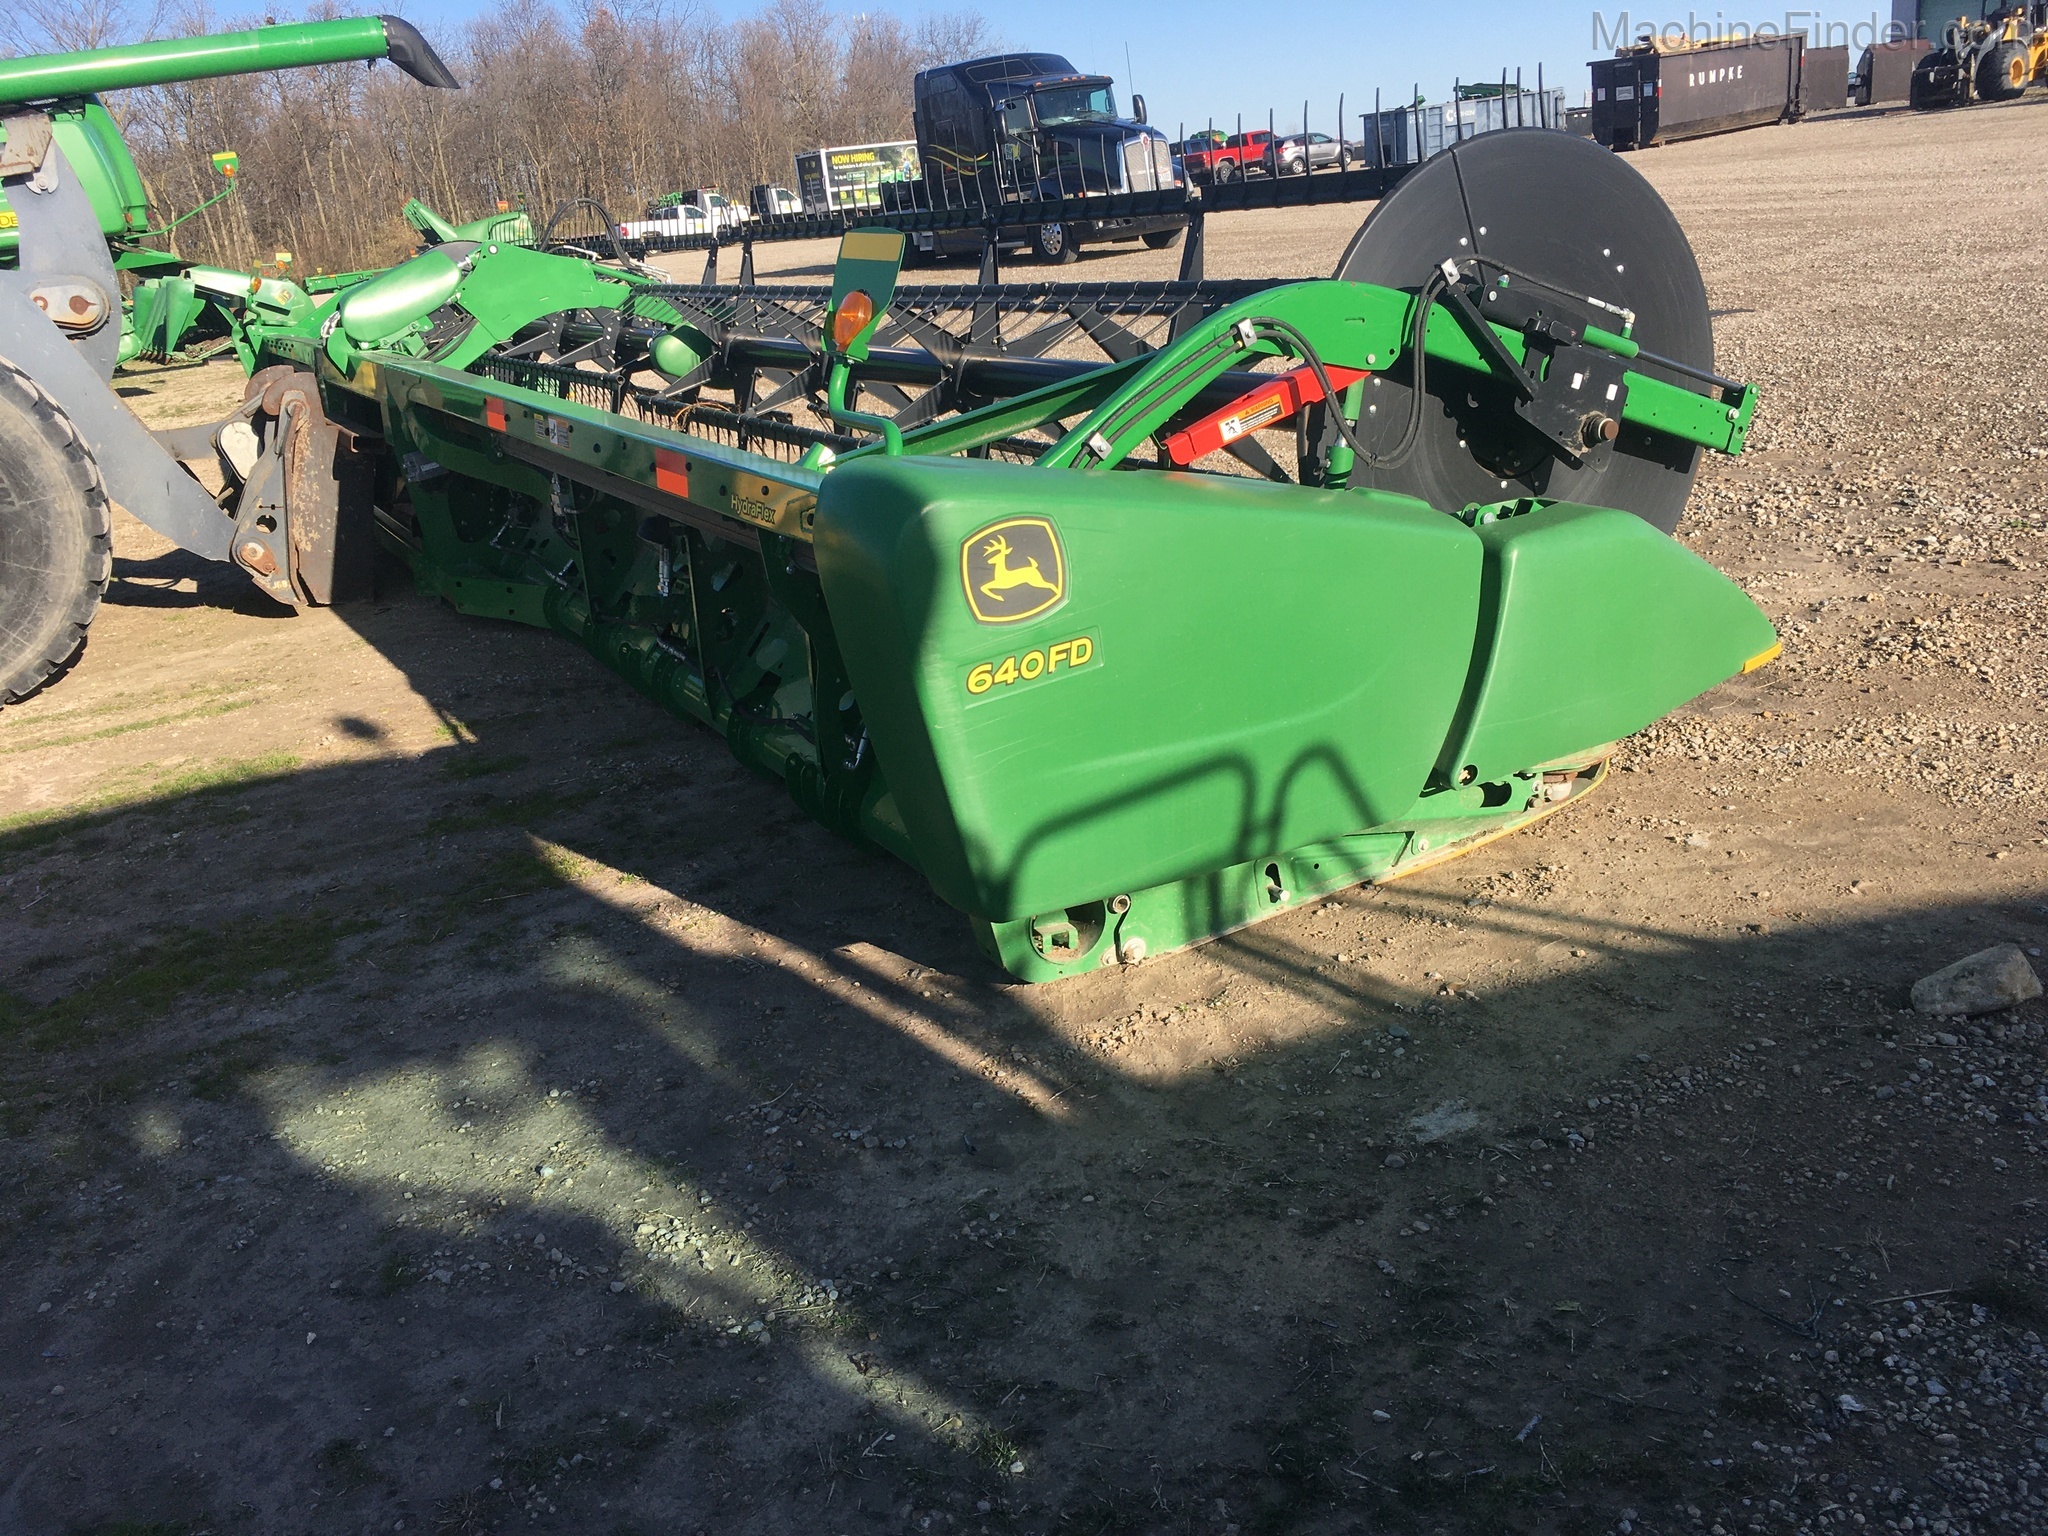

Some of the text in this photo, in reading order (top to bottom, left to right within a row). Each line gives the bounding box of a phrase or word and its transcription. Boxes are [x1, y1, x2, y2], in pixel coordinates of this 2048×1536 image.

[1689, 65, 1743, 87] RUMPKE
[831, 152, 875, 164] NOW HIRING
[731, 494, 776, 524] HydraFlex
[966, 636, 1094, 695] 640FD
